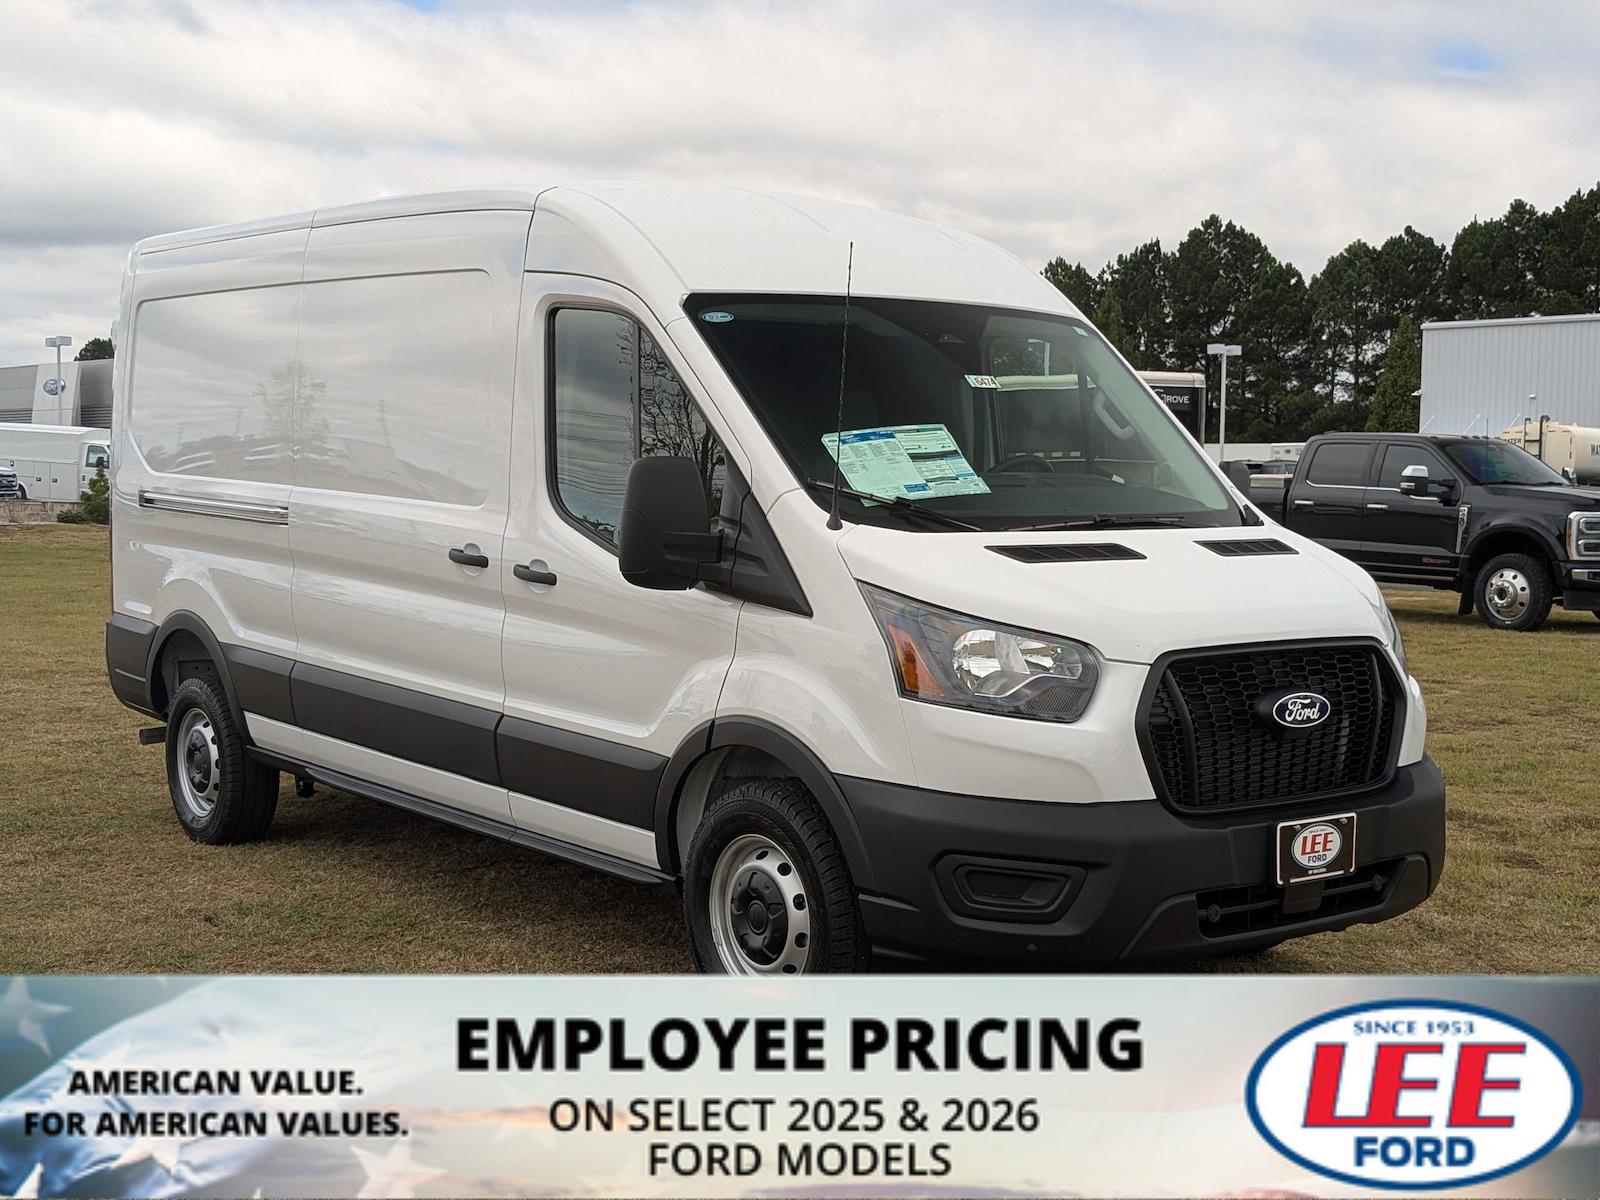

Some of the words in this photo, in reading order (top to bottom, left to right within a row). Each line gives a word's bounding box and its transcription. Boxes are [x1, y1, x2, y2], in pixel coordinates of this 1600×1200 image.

[1285, 698, 1320, 721] Ford
[1301, 831, 1334, 856] LEE
[1307, 853, 1327, 864] FORD
